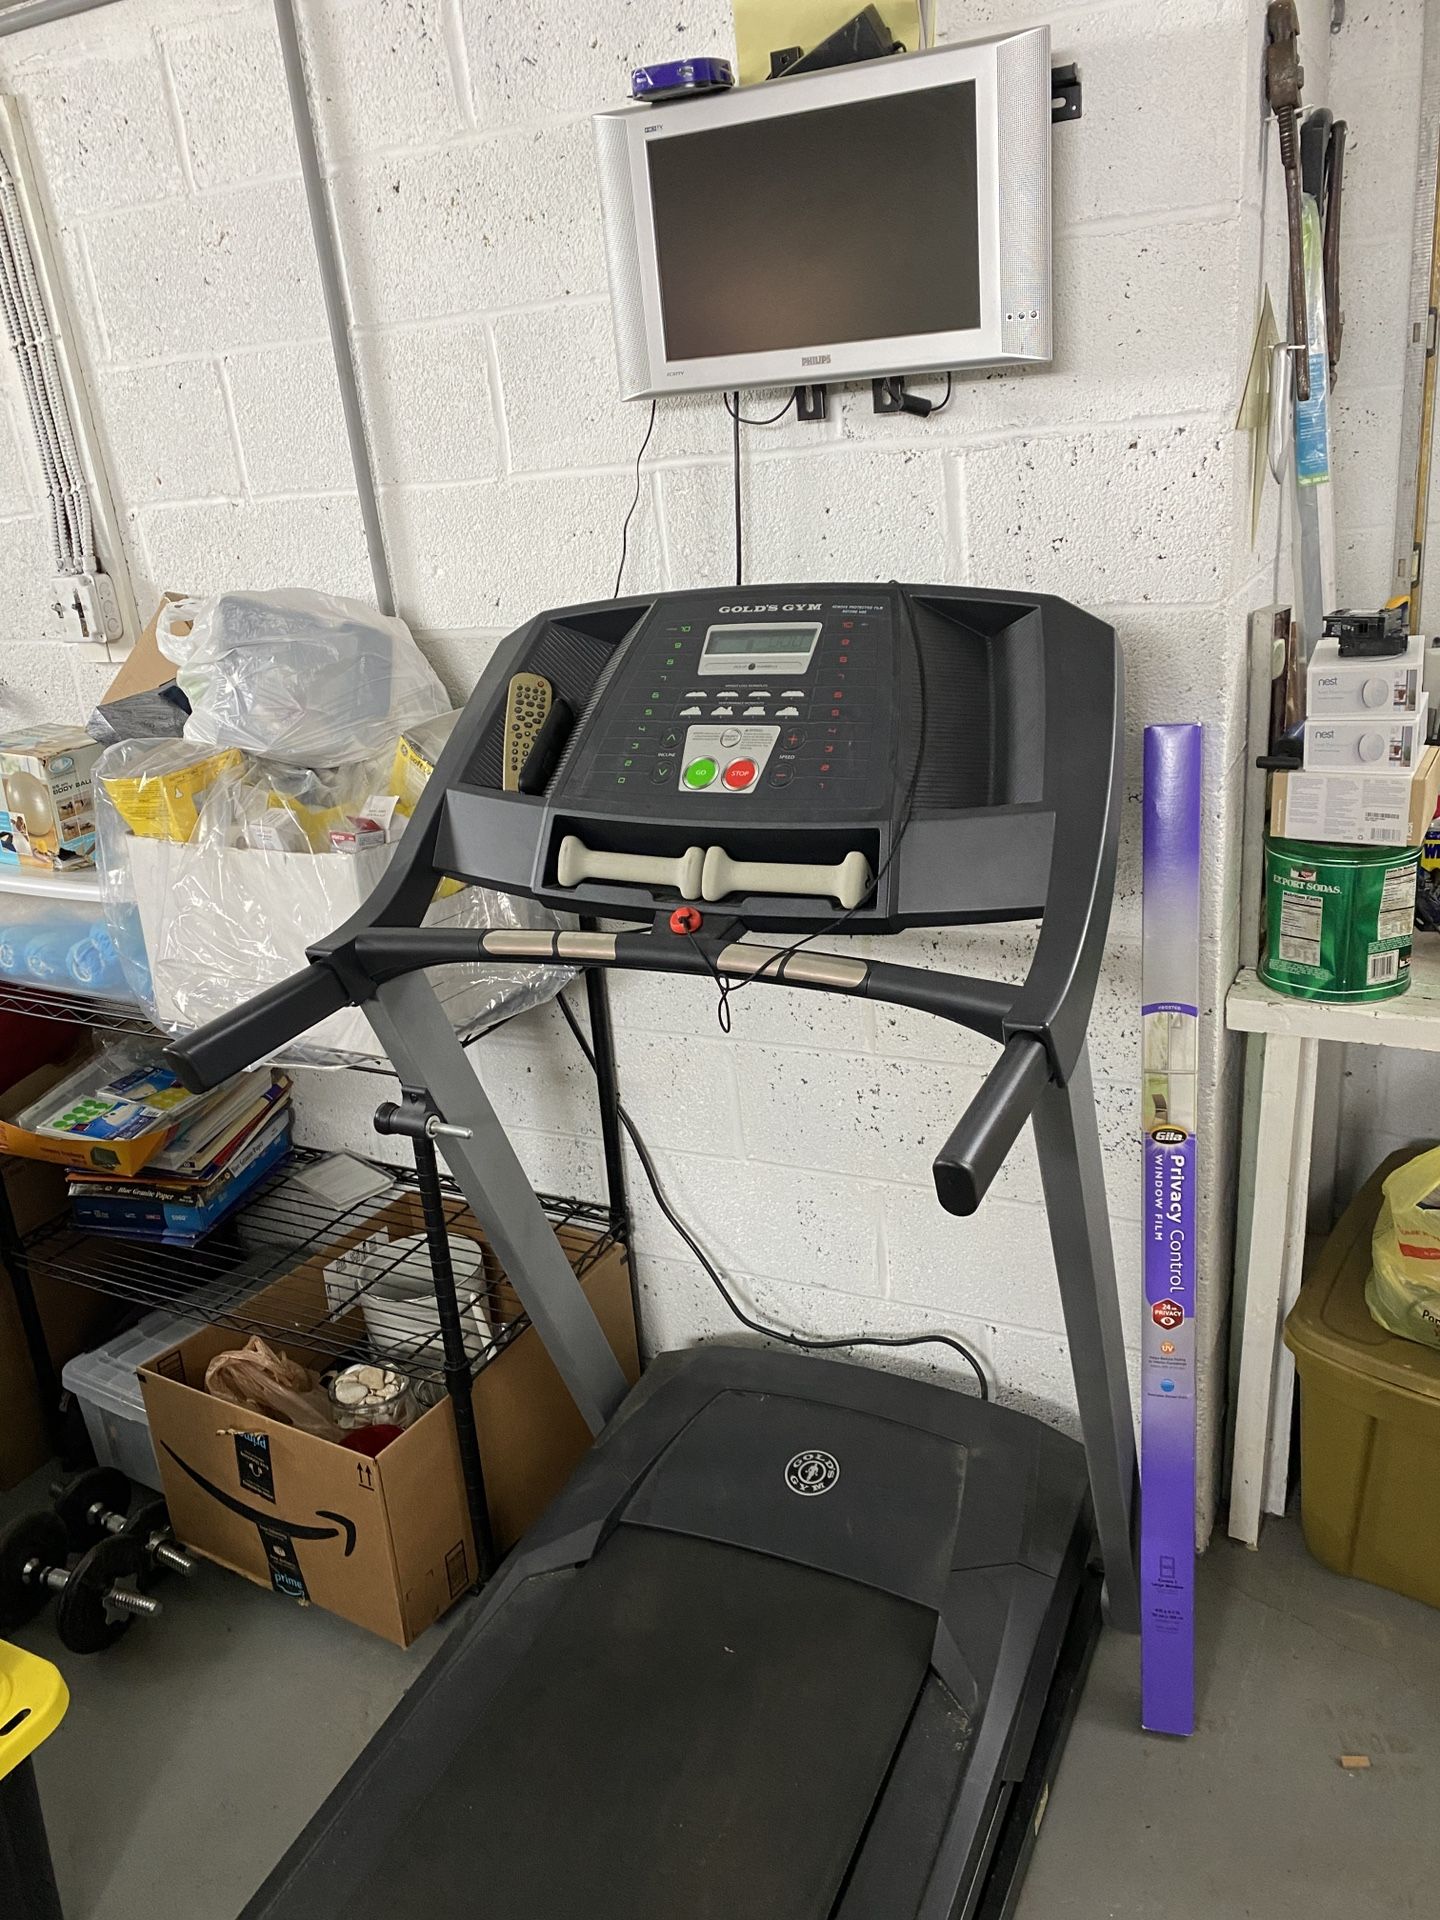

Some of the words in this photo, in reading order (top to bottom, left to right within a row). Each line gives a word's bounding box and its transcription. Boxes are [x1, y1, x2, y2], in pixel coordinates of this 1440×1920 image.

[802, 355, 832, 366] PHILIPS
[718, 604, 778, 613] GOLD'S
[782, 603, 822, 611] GYM
[1318, 677, 1338, 686] nest
[1315, 730, 1334, 739] nest
[53, 785, 73, 795] BODY
[1273, 874, 1305, 890] EXPORT
[1155, 1132, 1183, 1141] Gila
[1154, 1154, 1163, 1209] WINDOW
[1166, 1155, 1185, 1223] Privacy
[1154, 1213, 1163, 1241] FILM
[1170, 1230, 1185, 1293] Control
[793, 1454, 836, 1479] GOLD'S
[790, 1475, 825, 1491] GYM
[274, 1572, 303, 1588] prime
